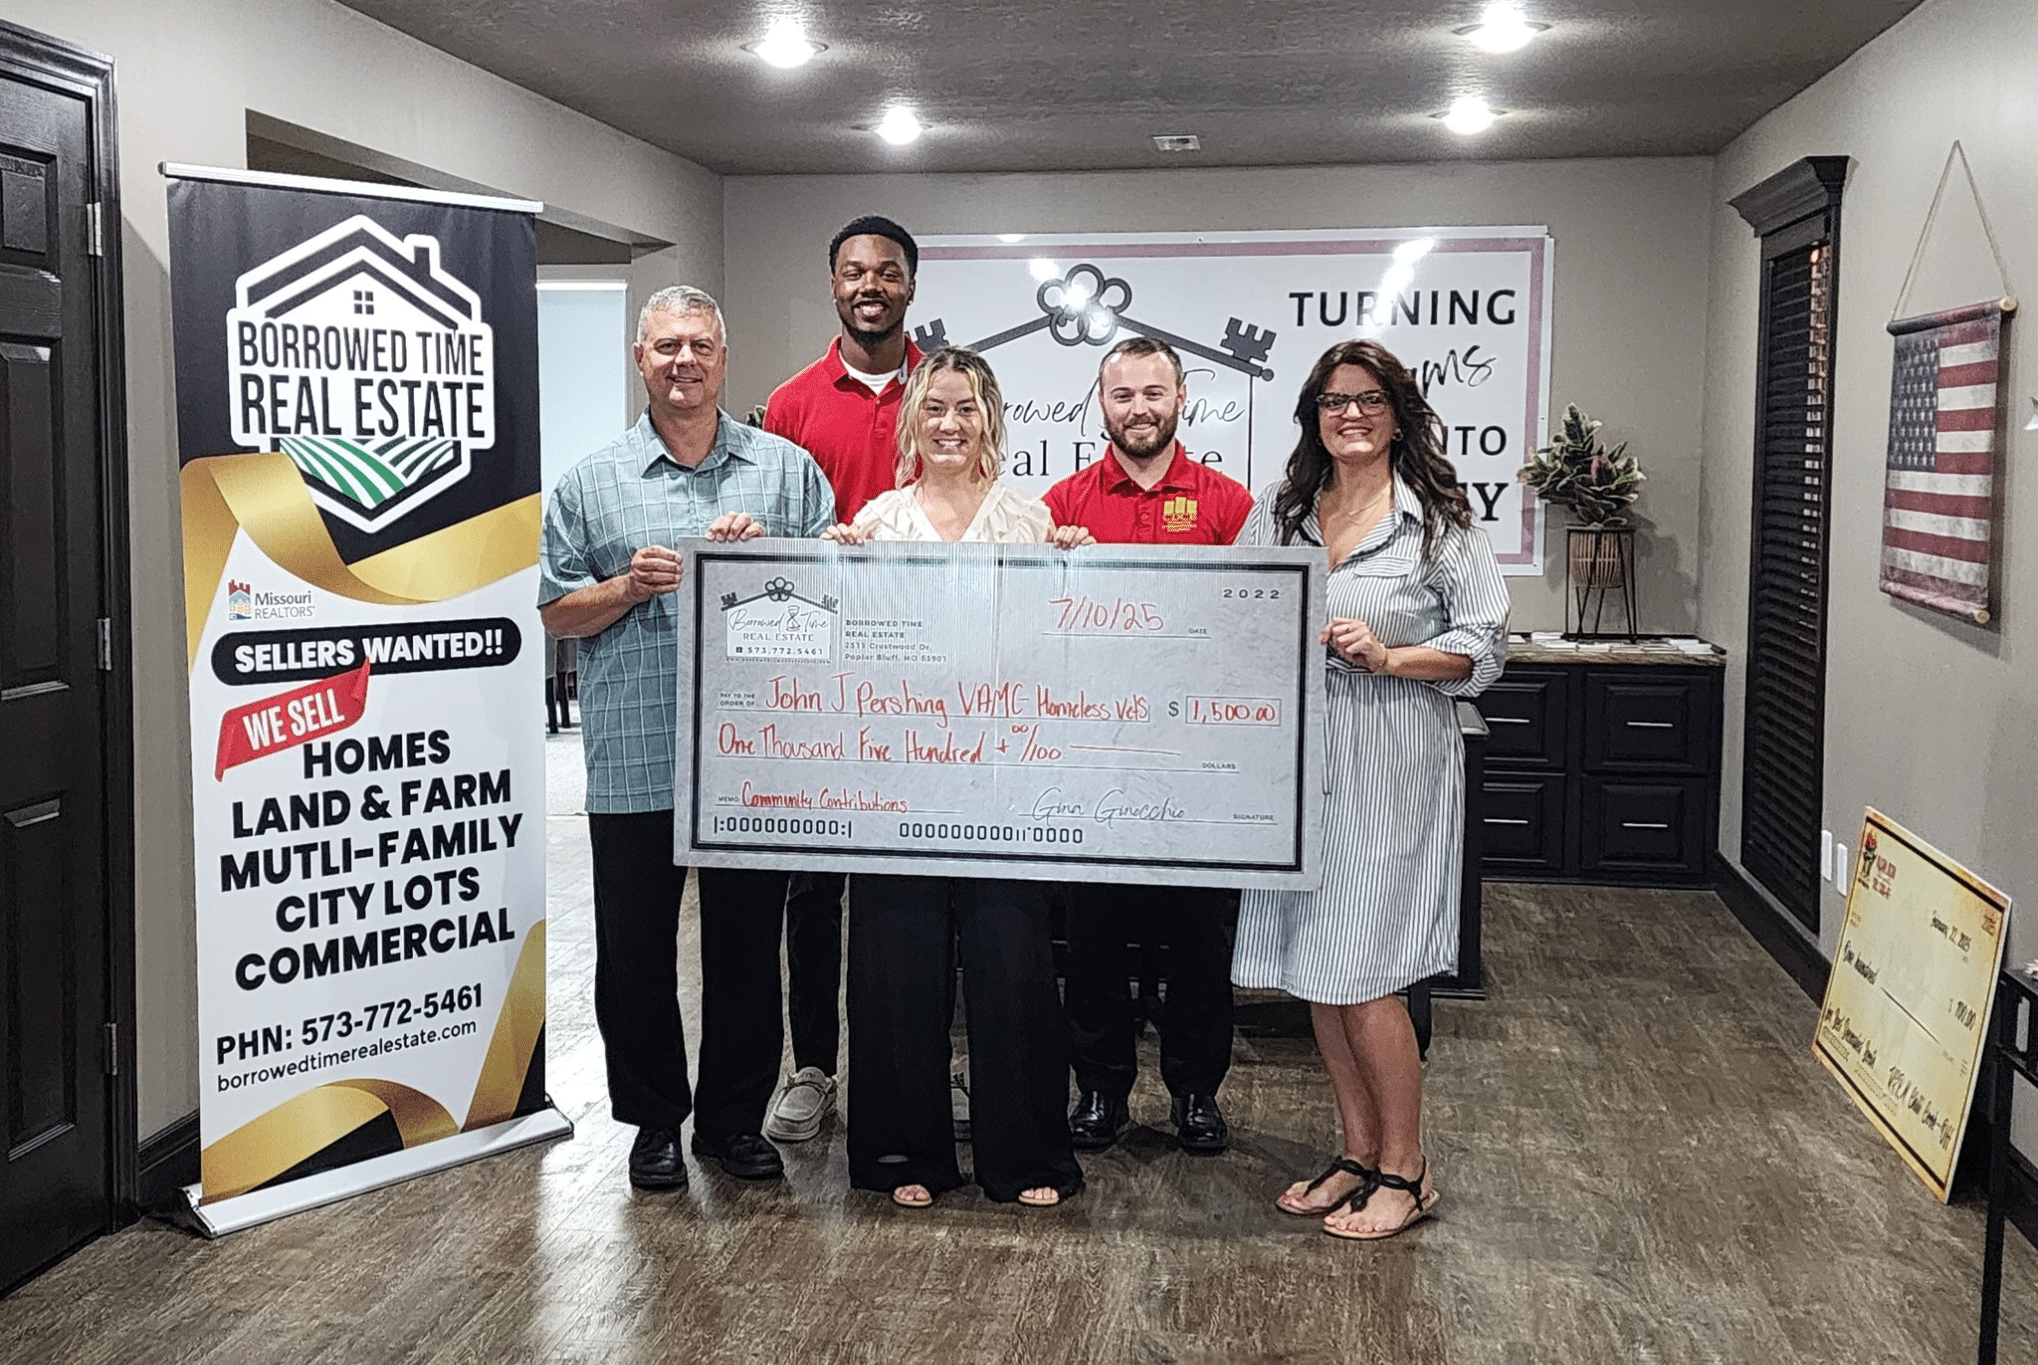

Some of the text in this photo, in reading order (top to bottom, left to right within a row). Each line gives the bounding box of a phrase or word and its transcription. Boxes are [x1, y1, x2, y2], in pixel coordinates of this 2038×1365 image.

[1289, 289, 1516, 327] TURNING
[238, 321, 484, 376] BORROWED TIME
[241, 373, 485, 438] REAL ESTATE
[255, 590, 312, 606] Missouri
[1223, 588, 1281, 600] 2022
[729, 608, 829, 632] Borrowed Time
[846, 619, 923, 628] BORROWED TIME
[1049, 595, 1164, 632] 7/10/25
[235, 628, 503, 673] SELLERS WANTED!!
[743, 632, 814, 642] REAL ESTATE
[748, 646, 823, 655] 573.772.5461
[845, 630, 905, 639] REAL ESTATE
[766, 675, 822, 711] John
[831, 672, 855, 711] J
[857, 679, 948, 728] Pershing
[1037, 684, 1111, 720] Homeless
[1168, 701, 1179, 717] $
[1192, 700, 1276, 723] 1,500.00
[242, 688, 345, 751] WE SELL
[303, 729, 450, 779] HOMES
[718, 722, 755, 756] One
[759, 723, 845, 761] Thousand
[859, 725, 891, 761] Five
[905, 729, 986, 764] Hundred
[1202, 762, 1236, 770] DOLLARS
[232, 768, 511, 839] LAND & FARM
[742, 780, 908, 813] Community Contributions
[1233, 813, 1275, 821] SIGNATURE
[220, 813, 523, 893] MUTLI-FAMILY
[276, 866, 480, 933] CITY LOTS
[235, 907, 515, 991] COMMERCIAL
[217, 983, 483, 1066] PHN: 573-772-5461
[217, 1020, 477, 1093] borrowedtimerealestate.com
